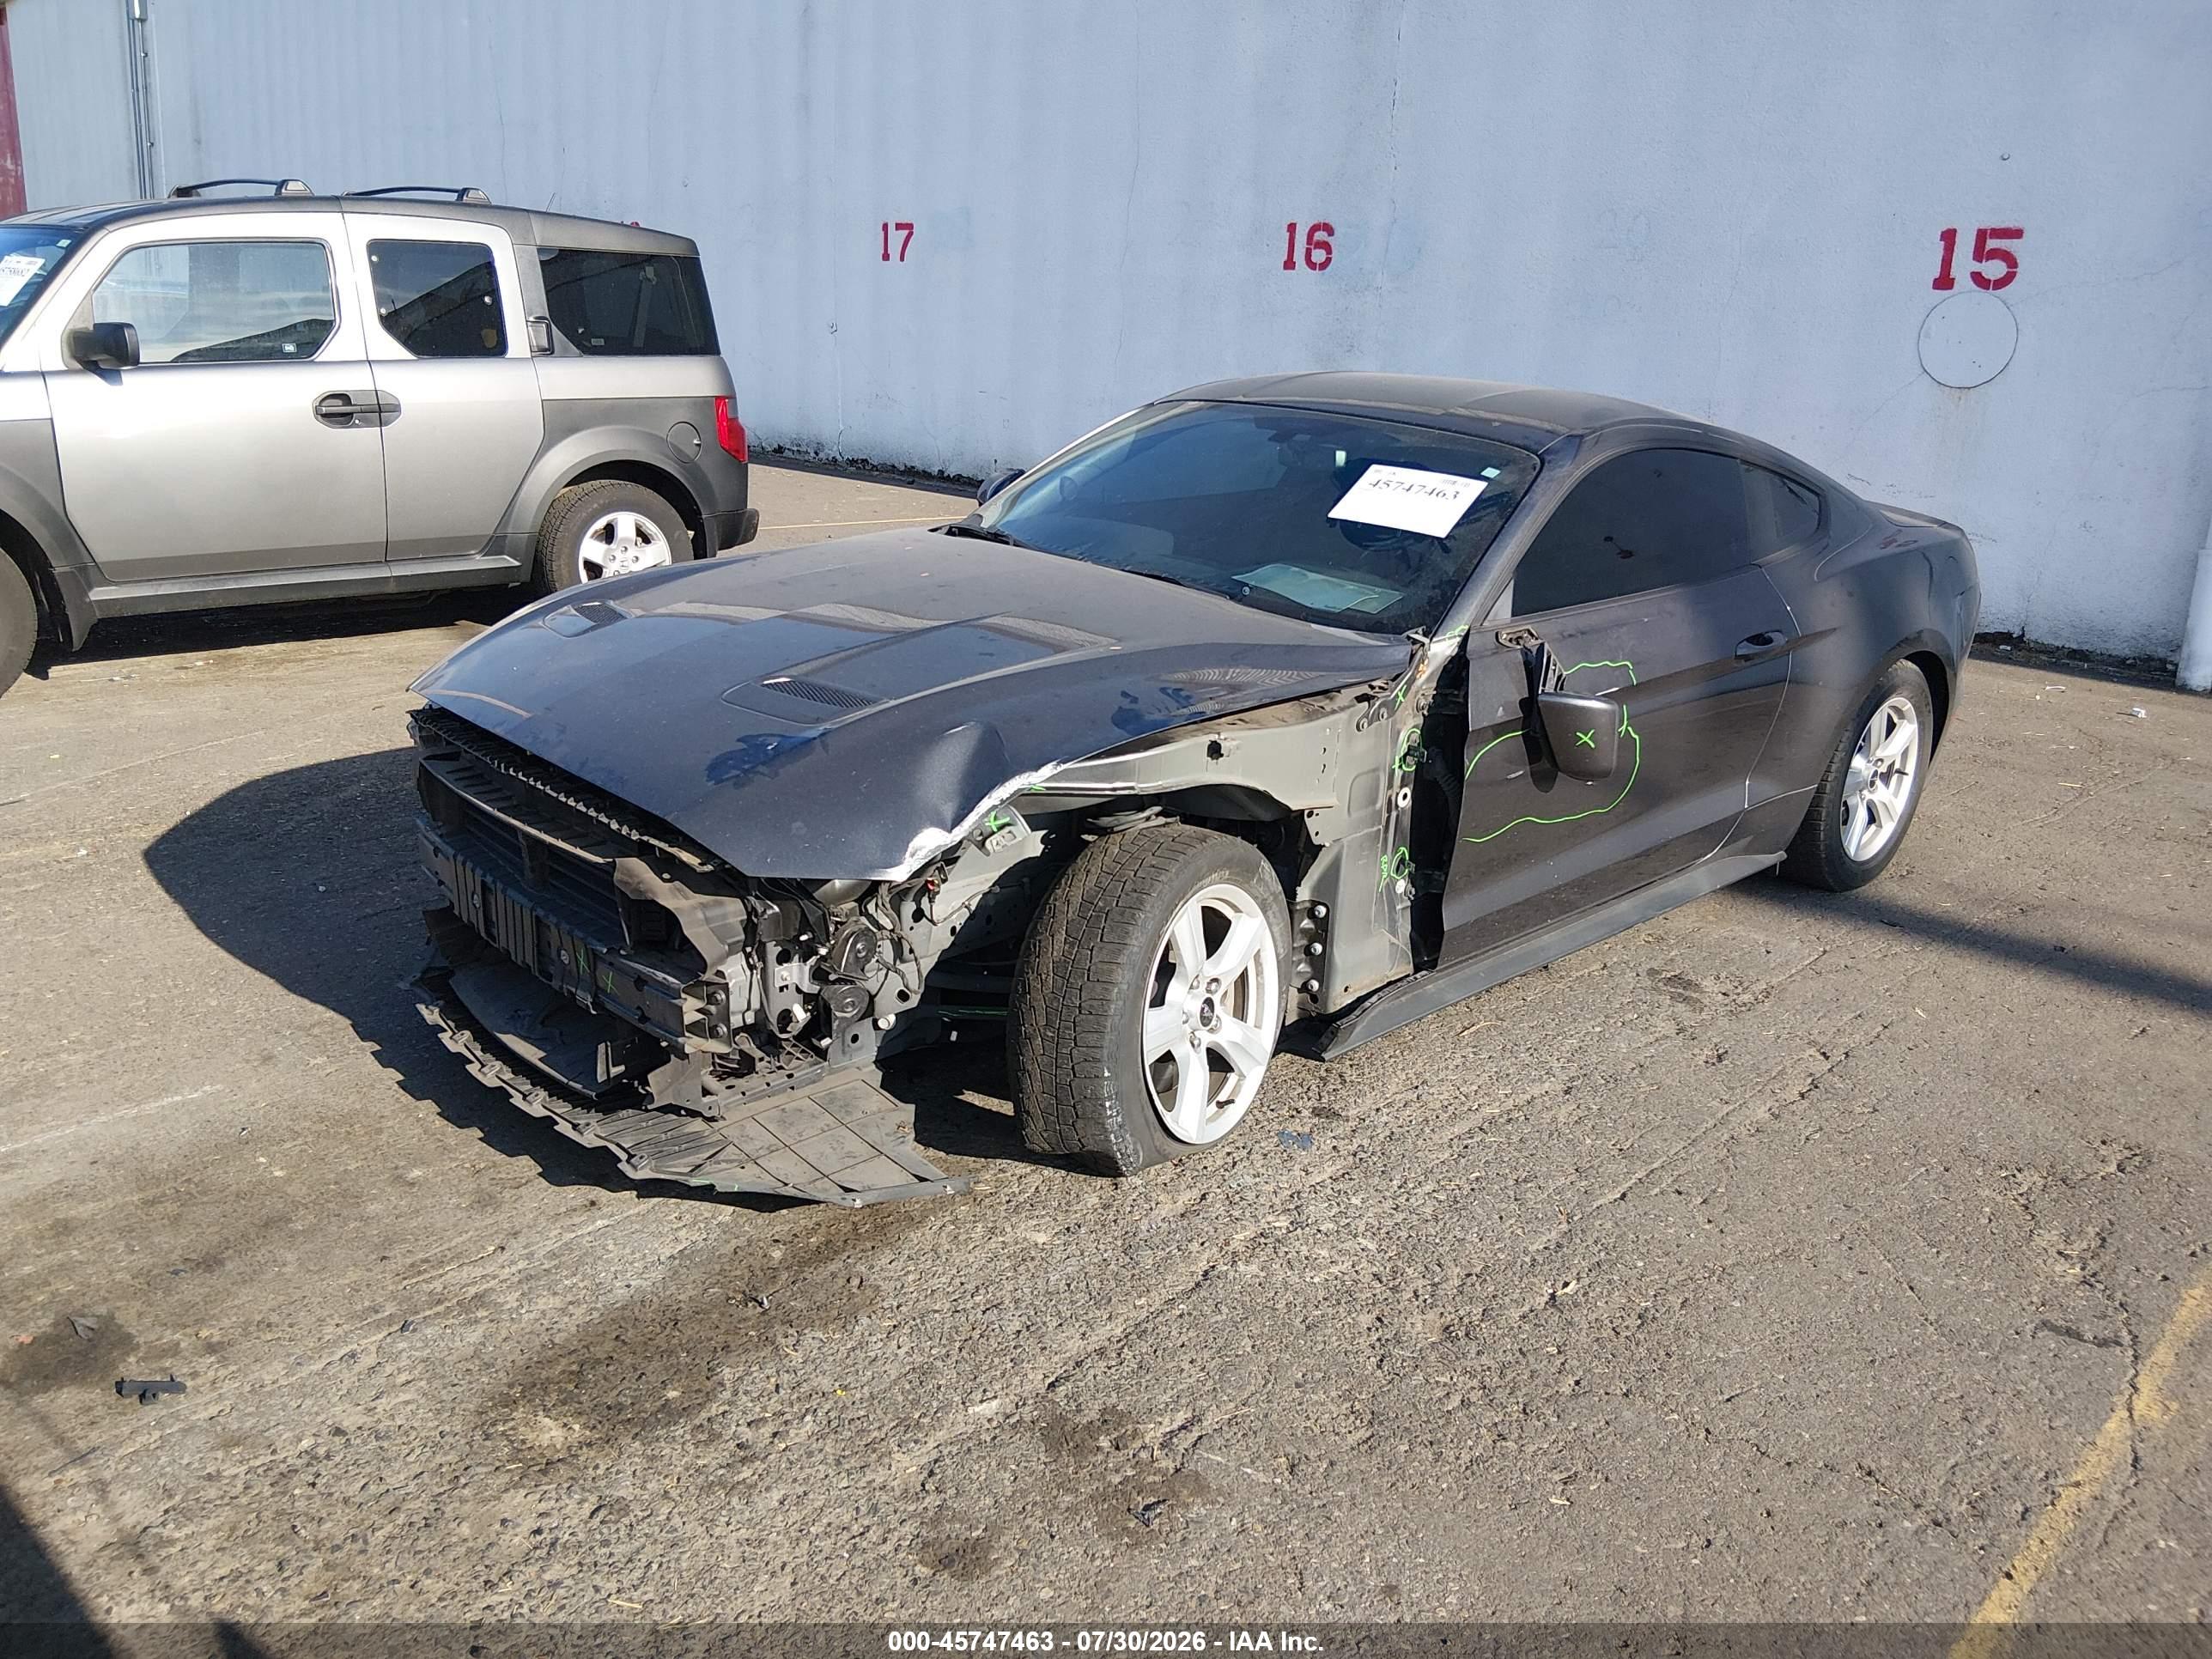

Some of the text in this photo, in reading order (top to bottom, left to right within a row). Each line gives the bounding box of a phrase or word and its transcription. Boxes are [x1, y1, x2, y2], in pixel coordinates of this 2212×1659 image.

[882, 222, 914, 262] 17
[1284, 222, 1334, 271] 16
[1933, 227, 2024, 290] 15
[1368, 477, 1461, 501] 45747463
